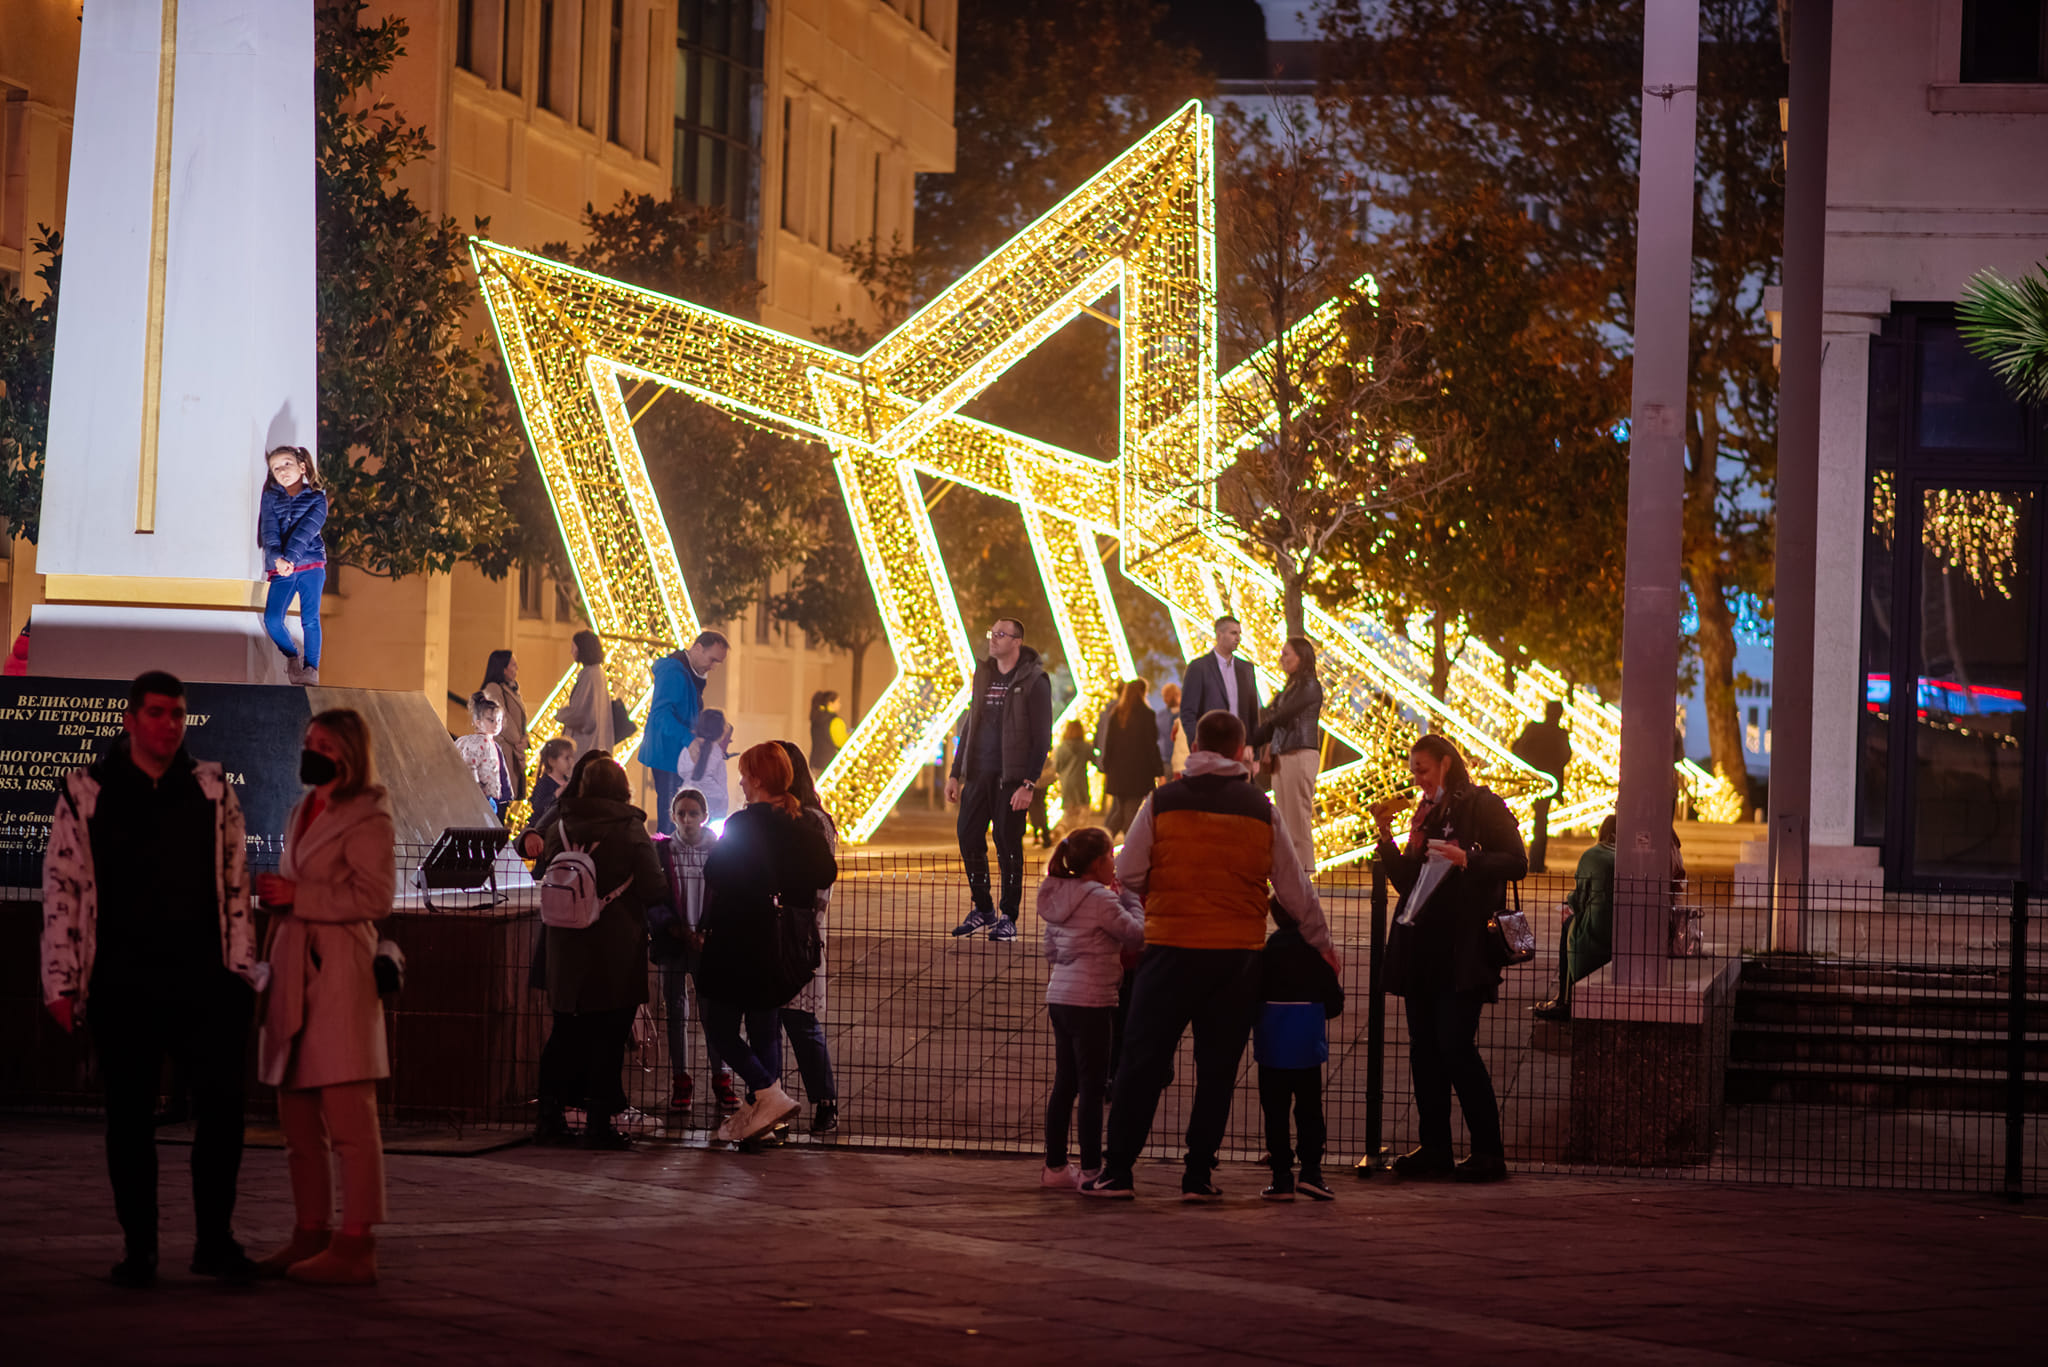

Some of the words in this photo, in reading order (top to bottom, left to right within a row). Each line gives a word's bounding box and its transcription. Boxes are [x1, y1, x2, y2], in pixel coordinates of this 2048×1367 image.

[17, 695, 105, 709] ВЕЛИКОМЕ
[80, 739, 93, 750] И
[0, 764, 25, 776] МА
[25, 778, 56, 792] 1858,
